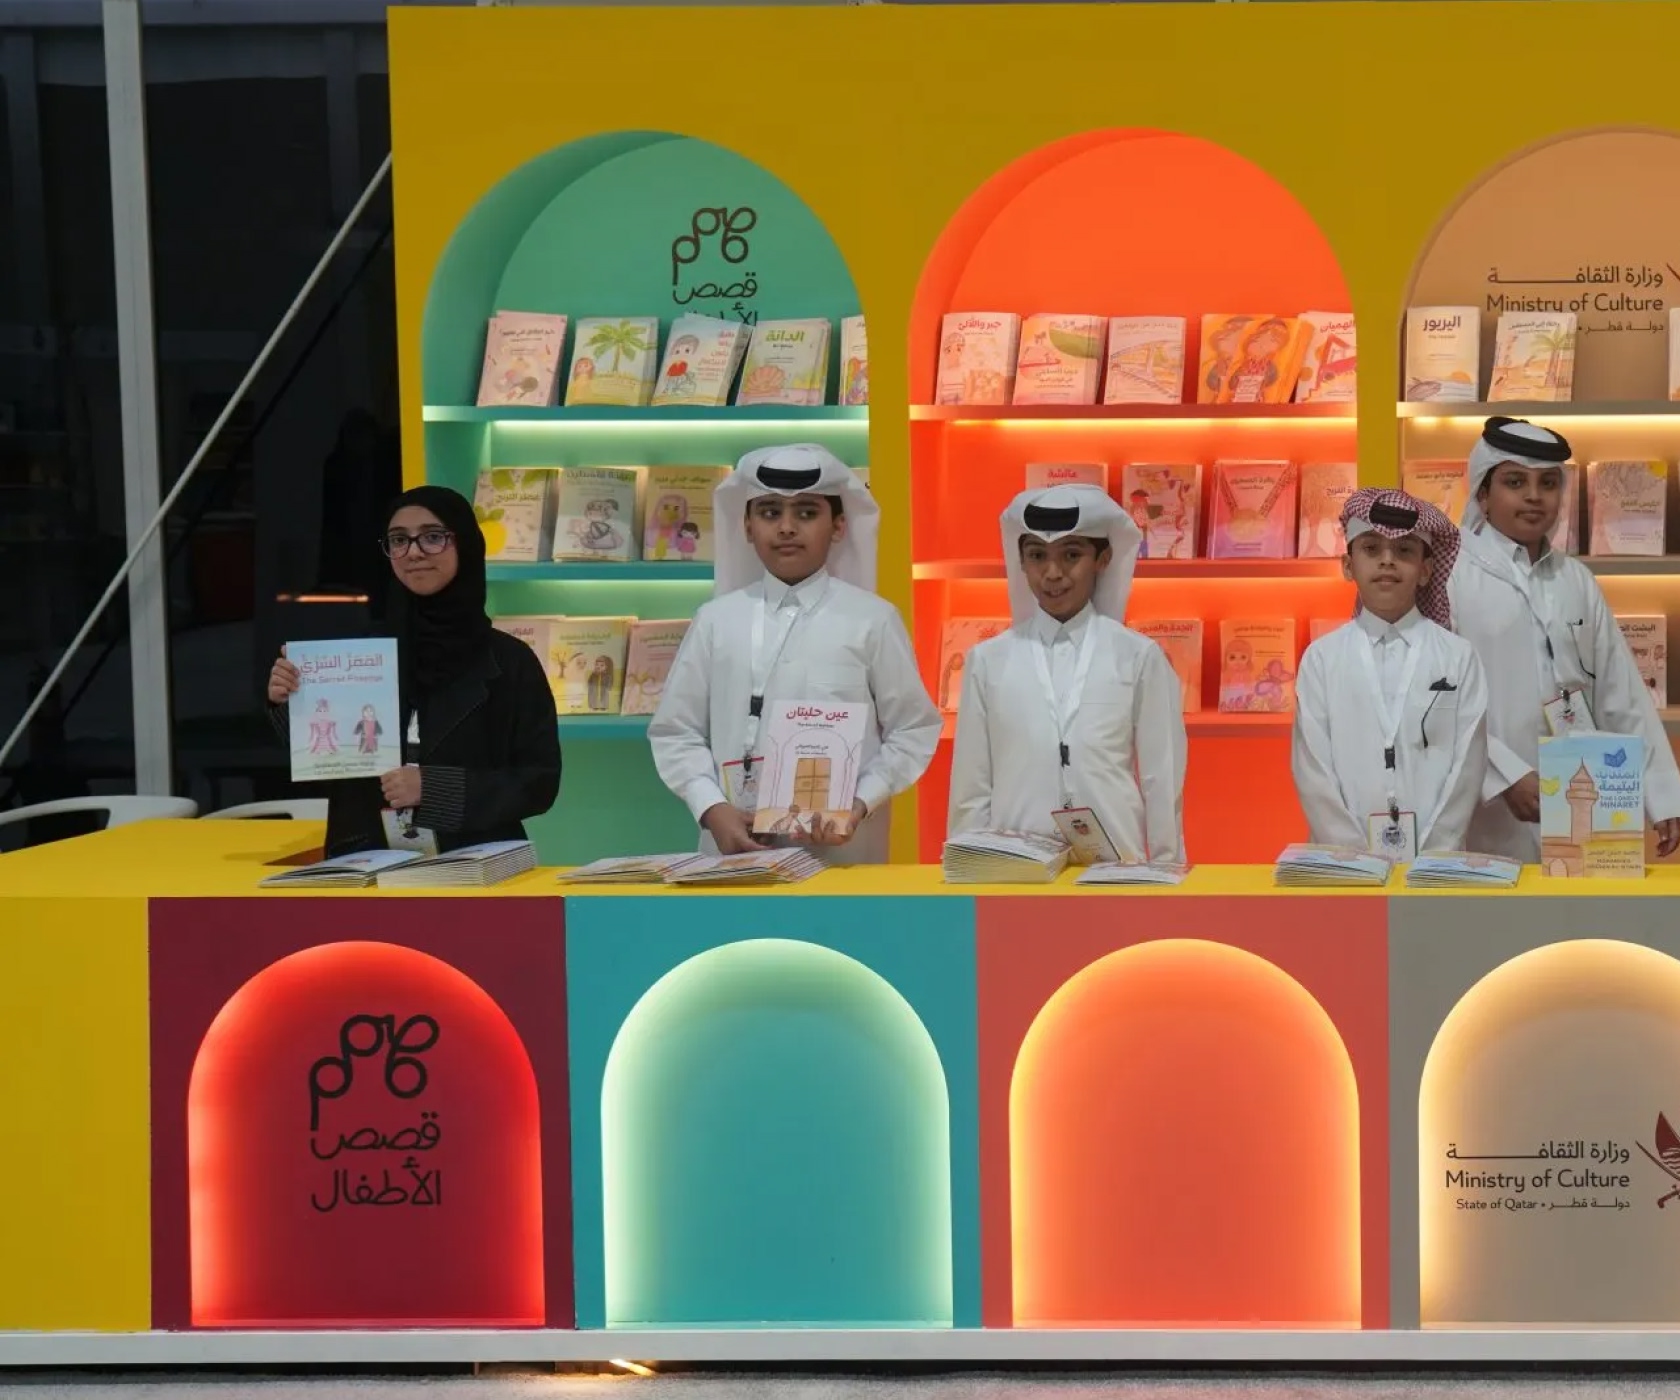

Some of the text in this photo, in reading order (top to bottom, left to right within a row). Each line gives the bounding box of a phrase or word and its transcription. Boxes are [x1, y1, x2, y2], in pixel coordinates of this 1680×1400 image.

[672, 270, 758, 304] قصص
[1487, 265, 1664, 289] وزارة الثقافة
[1486, 292, 1664, 313] Ministry of Culture
[1600, 800, 1639, 809] MINARET
[310, 1111, 441, 1161] قصص
[1445, 1139, 1630, 1164] وزارة الثقافة
[310, 1156, 442, 1213] الأطفال
[1445, 1168, 1630, 1193] Ministry of Culture
[1456, 1198, 1538, 1212] State of Qatar
[1549, 1197, 1630, 1212] دولة قطر
